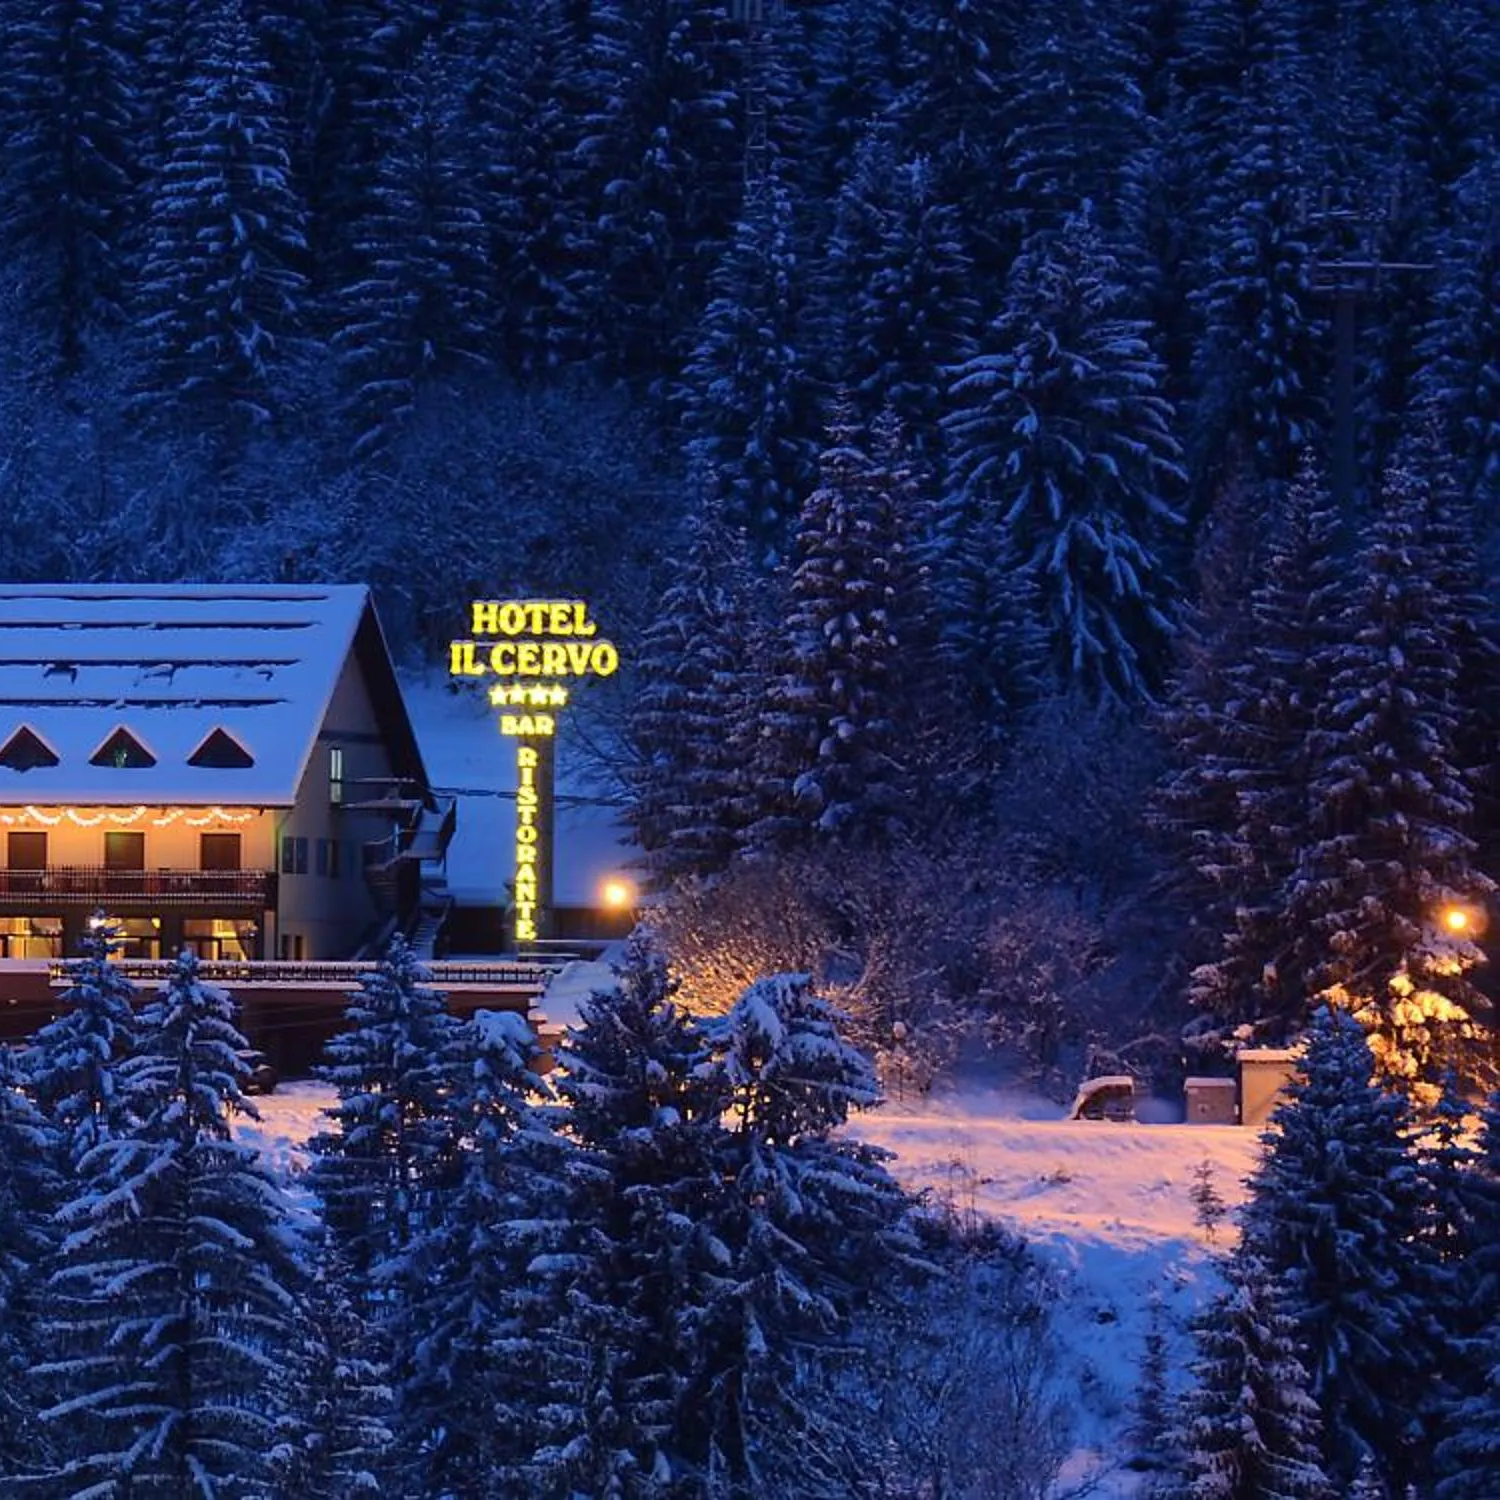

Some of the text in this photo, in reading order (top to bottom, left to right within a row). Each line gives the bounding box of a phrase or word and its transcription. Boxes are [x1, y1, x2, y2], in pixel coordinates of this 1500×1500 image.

[471, 601, 596, 635] HOTEL
[450, 641, 619, 676] IL CERVO
[501, 715, 554, 736] BAR
[516, 747, 537, 941] RISTORANTE
